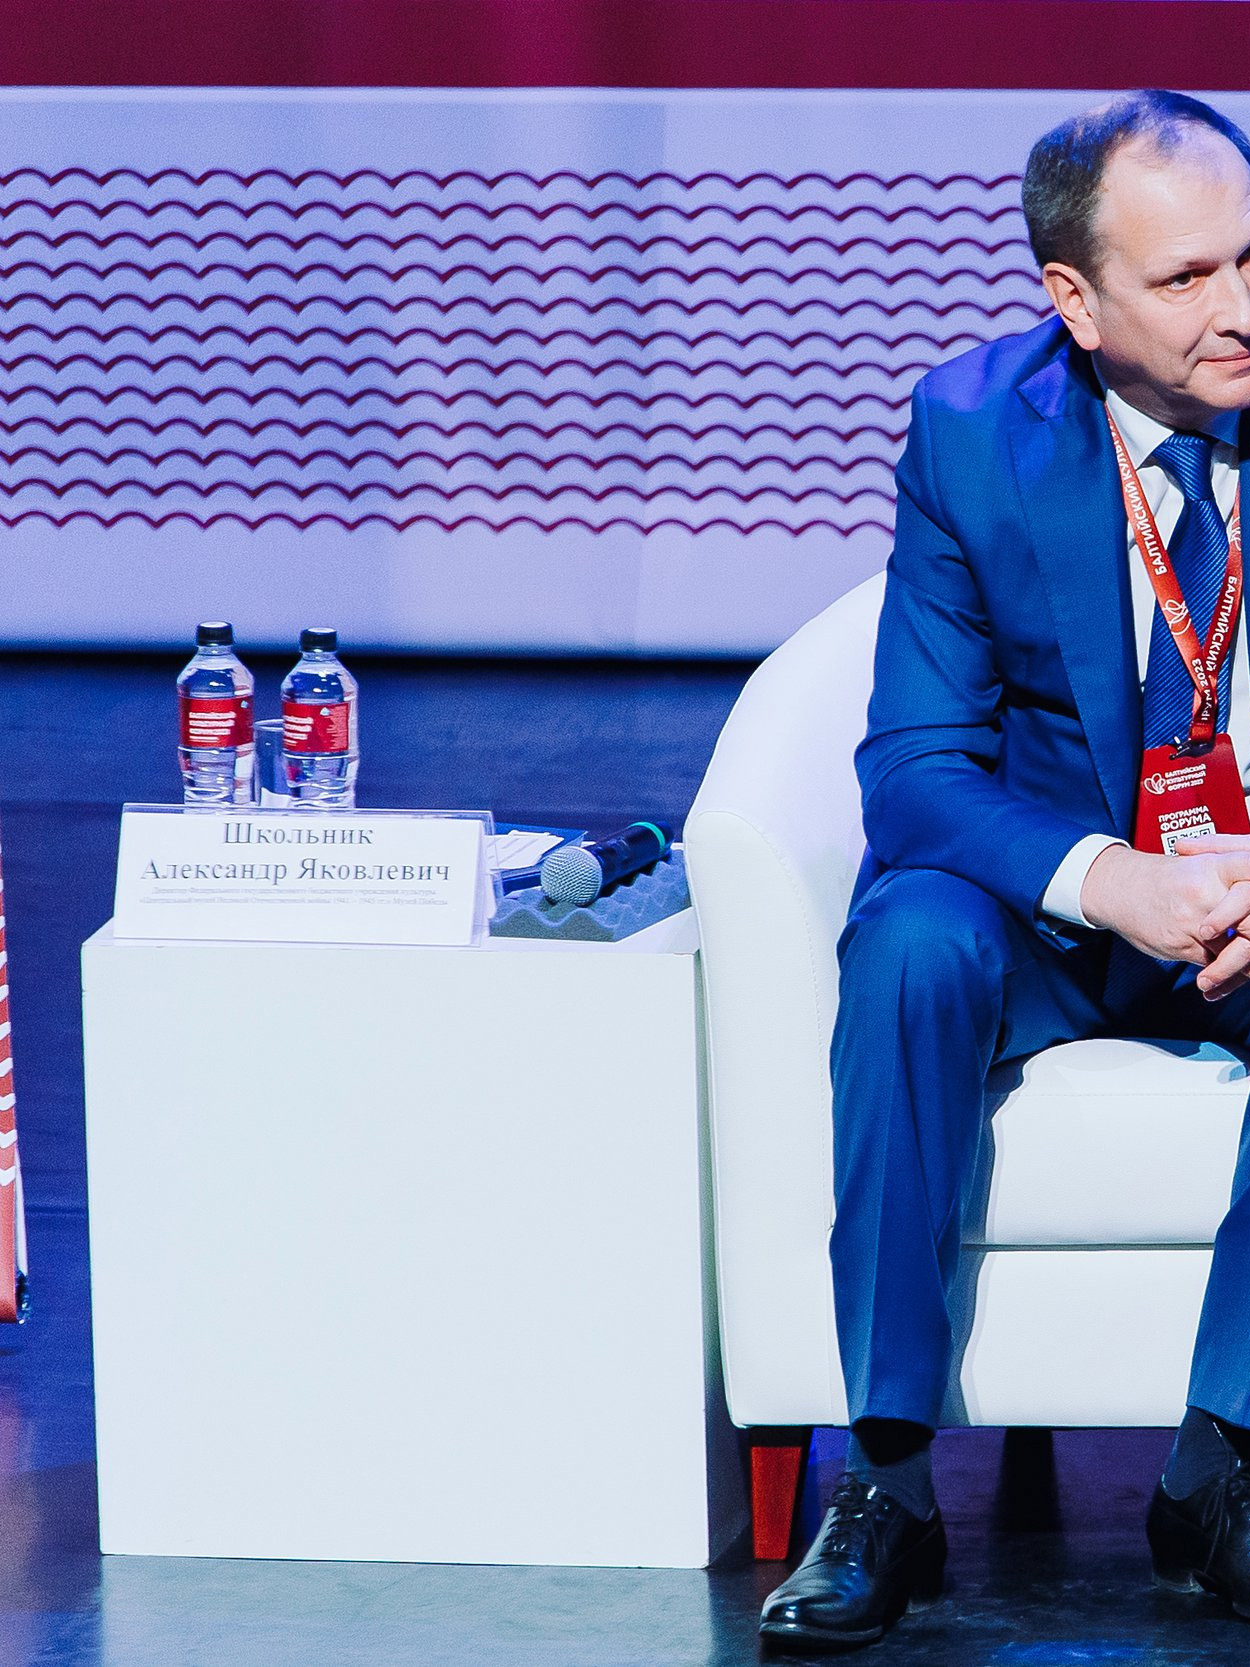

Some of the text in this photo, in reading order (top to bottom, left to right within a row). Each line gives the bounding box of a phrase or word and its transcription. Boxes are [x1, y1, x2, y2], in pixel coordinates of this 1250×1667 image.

[1124, 481, 1168, 575] БАЛТИЙСКИЙ
[1206, 575, 1238, 671] БАЛТИЙСКИЙ
[1191, 658, 1209, 687] 2023
[1158, 805, 1209, 823] ПРОГРАММА
[1160, 813, 1212, 832] ФОРУМА
[223, 822, 374, 845] Школьник
[140, 857, 451, 886] Александр Яковлевич
